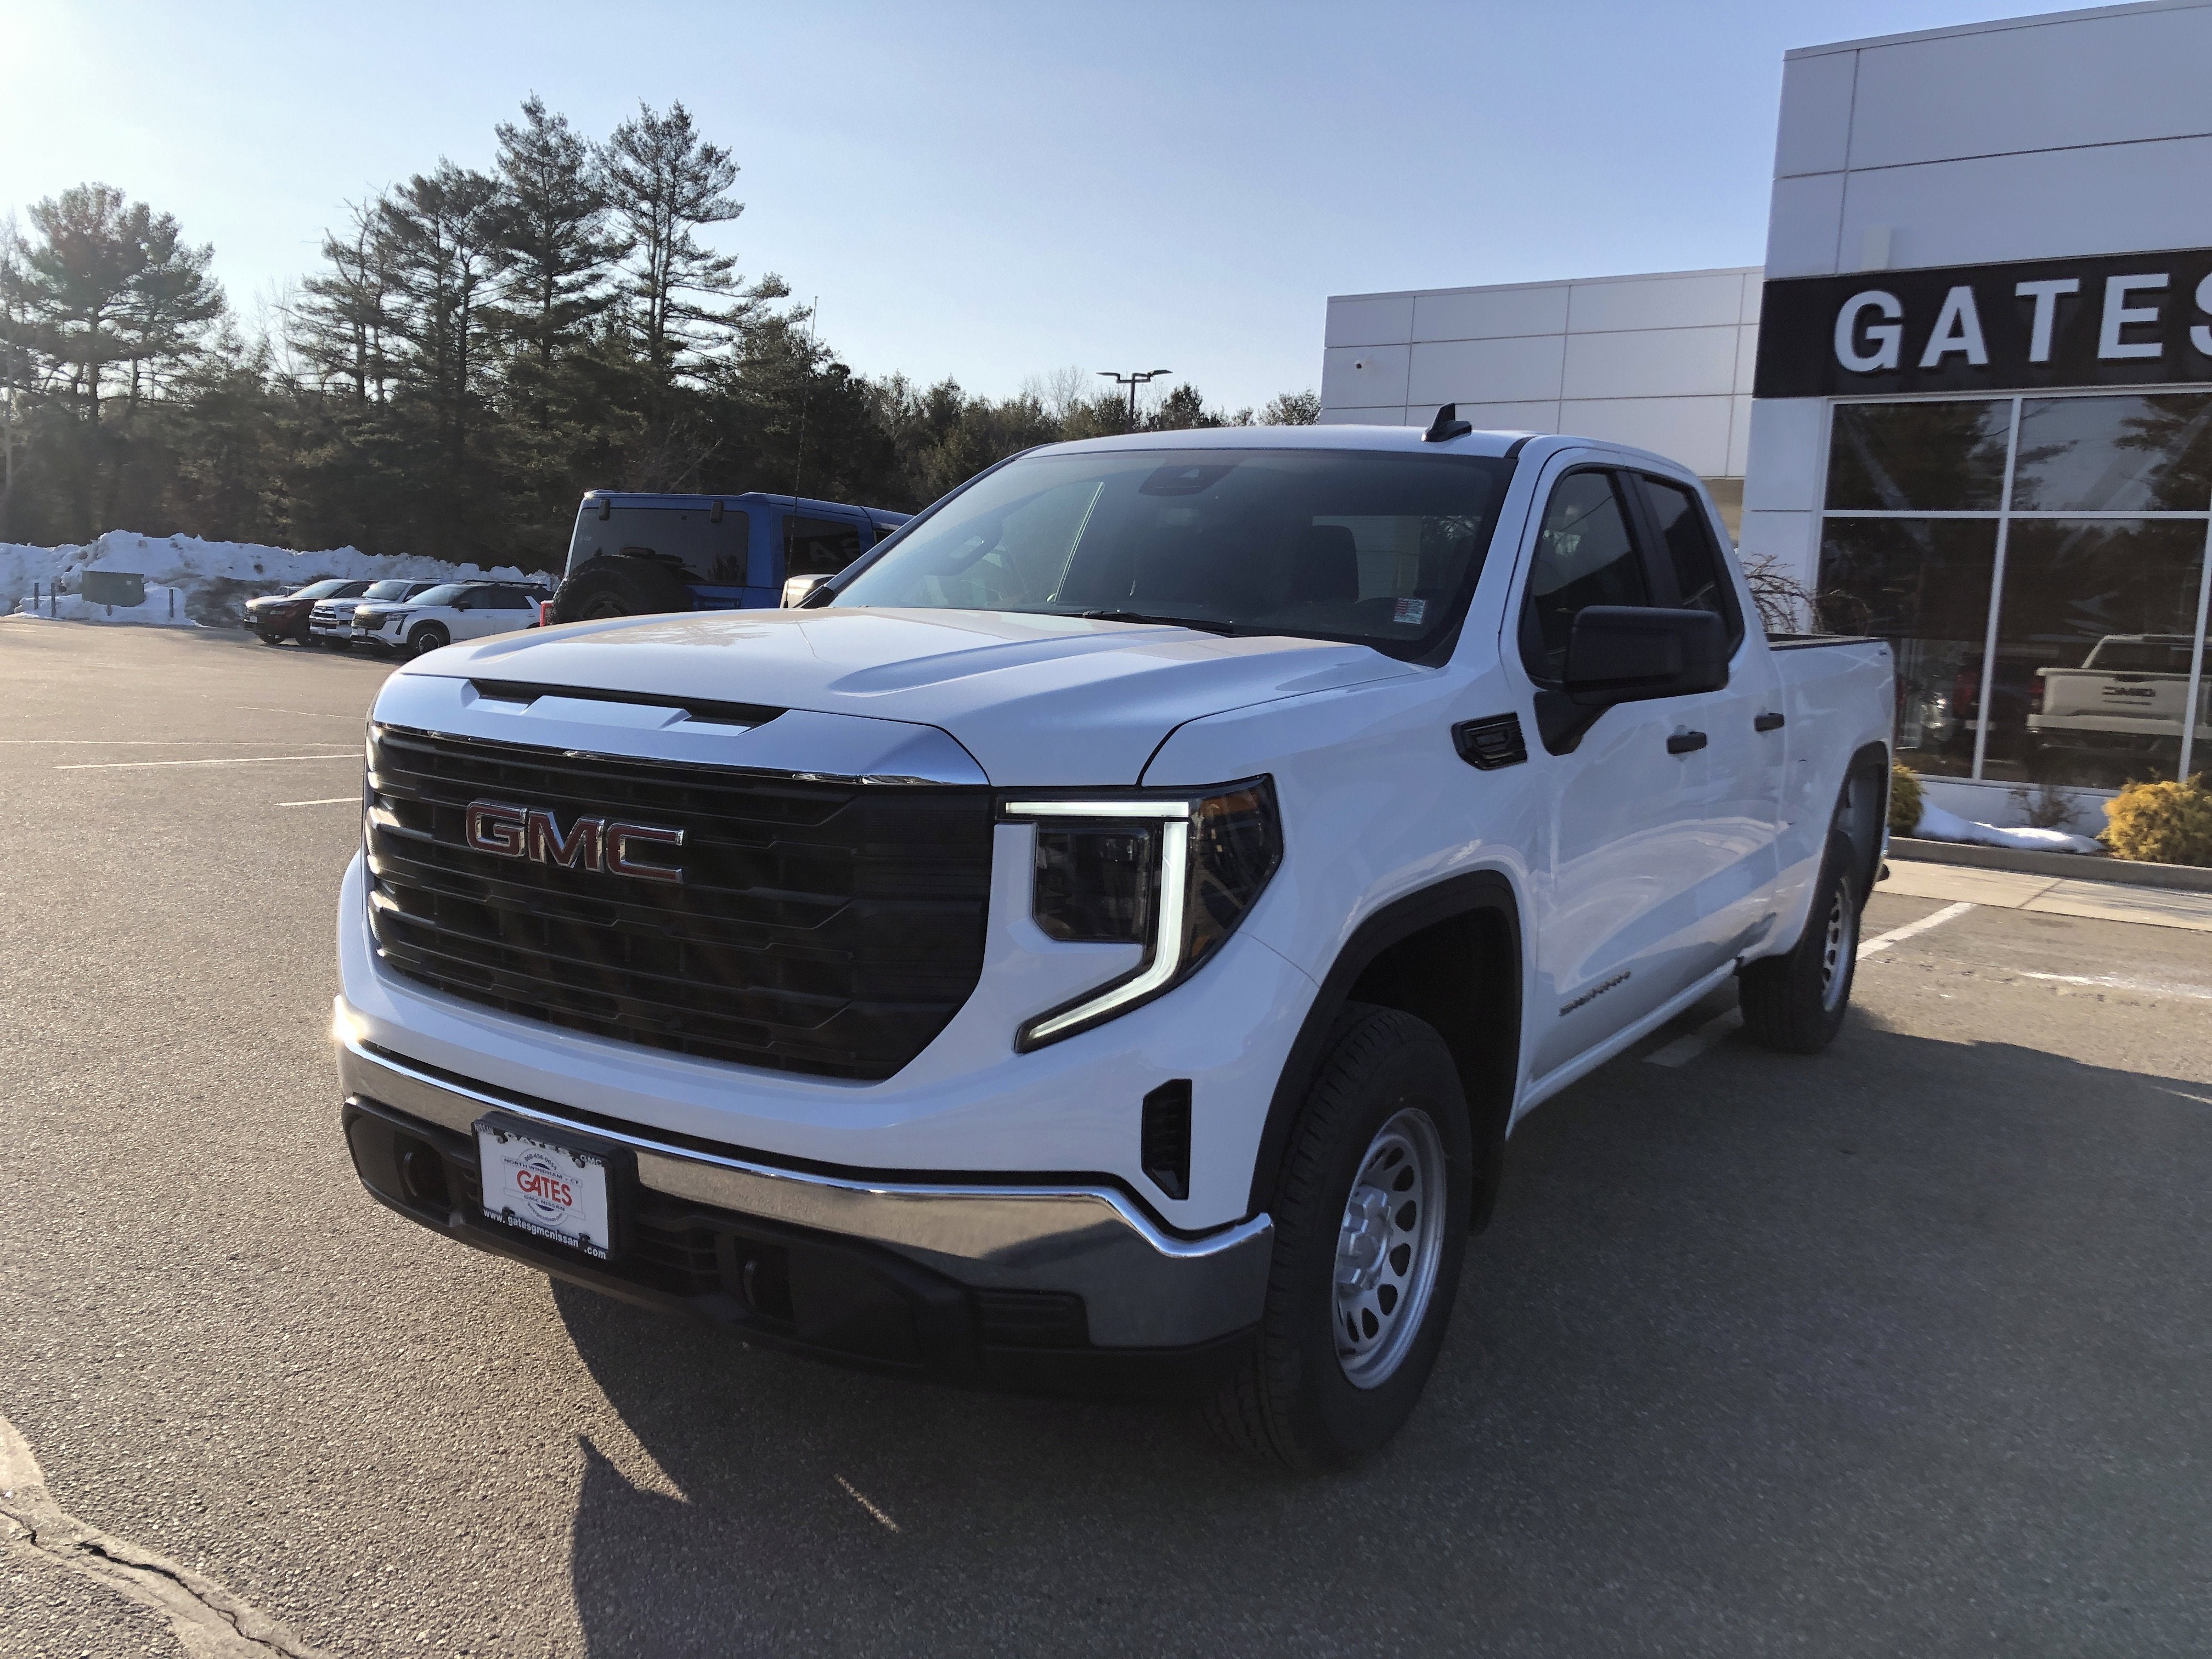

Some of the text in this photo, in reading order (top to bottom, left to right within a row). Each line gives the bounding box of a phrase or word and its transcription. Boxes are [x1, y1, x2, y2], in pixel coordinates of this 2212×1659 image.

[466, 799, 685, 884] GMC
[504, 1158, 527, 1168] NORTH
[528, 1165, 562, 1179] WINDHAM
[517, 1170, 572, 1206] GATES
[540, 1200, 565, 1212] NISSAN
